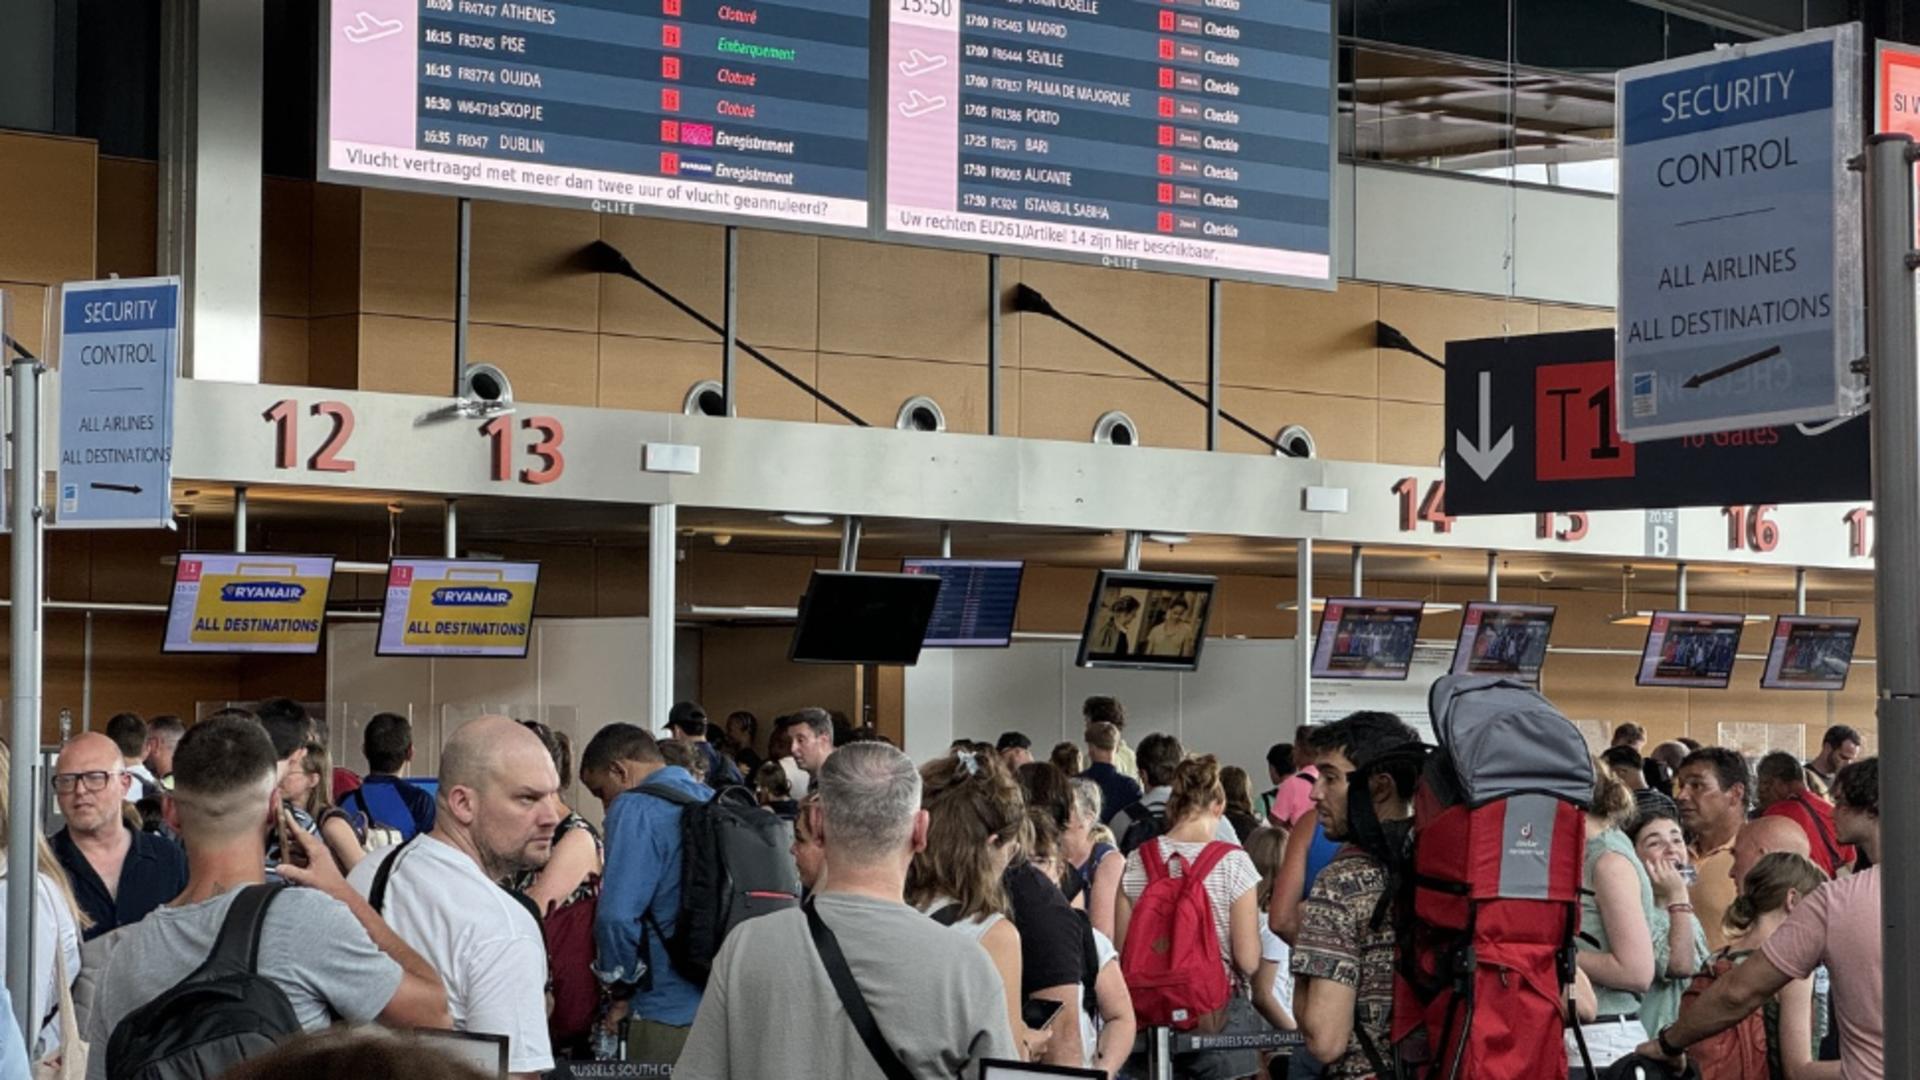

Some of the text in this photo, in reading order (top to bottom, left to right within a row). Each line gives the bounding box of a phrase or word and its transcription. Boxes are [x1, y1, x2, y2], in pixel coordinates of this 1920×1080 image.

[501, 4, 556, 25] ATHENES
[1026, 19, 1068, 38] MADRID
[501, 36, 526, 53] PISE
[1026, 48, 1065, 68] SEVILLE
[501, 69, 542, 88] OUJDA
[1026, 78, 1061, 97] PALMA
[1062, 84, 1076, 100] DE
[1077, 87, 1131, 107] MAJORQUE
[1661, 69, 1795, 123] SECURITY
[1893, 92, 1907, 113] SI
[500, 102, 543, 121] SKOPJE
[1026, 108, 1060, 126] PORTO
[500, 134, 545, 154] DUBLIN
[1657, 137, 1798, 187] CONTROL
[346, 148, 829, 217] Vlucht vertraagd met meer dan twee uur of vlucht geannuleerd?
[1025, 168, 1072, 186] ALICANTE
[591, 199, 636, 215] Q-LITE
[1025, 197, 1071, 217] ISTANBUL
[900, 210, 921, 226] Uw
[926, 214, 977, 233] rechten
[1071, 229, 1086, 245] 14
[1090, 232, 1111, 250] zijn
[1115, 233, 1140, 251] hier
[1101, 255, 1139, 270] Q-LITE
[1658, 247, 1797, 290] ALL AIRLINES
[84, 299, 158, 324] SECURITY
[1628, 293, 1831, 344] ALL DESTINATIONS
[80, 343, 157, 366] CONTROL
[79, 415, 154, 432] ALL AIRLINES
[1545, 384, 1620, 462] T1
[262, 399, 356, 473] 12
[62, 446, 172, 465] ALL DESTINATIONS
[478, 413, 565, 485] 13
[1391, 477, 1456, 533] 14
[1721, 504, 1779, 552] 16
[1842, 507, 1873, 558] 1
[1654, 525, 1669, 557] B
[234, 586, 302, 598] RYANAIR
[444, 591, 509, 603] RYANAIR
[195, 617, 320, 632] ALL DESTINATIONS
[407, 621, 526, 636] ALL DESTINATIONS
[617, 1063, 658, 1077] SOUTH
